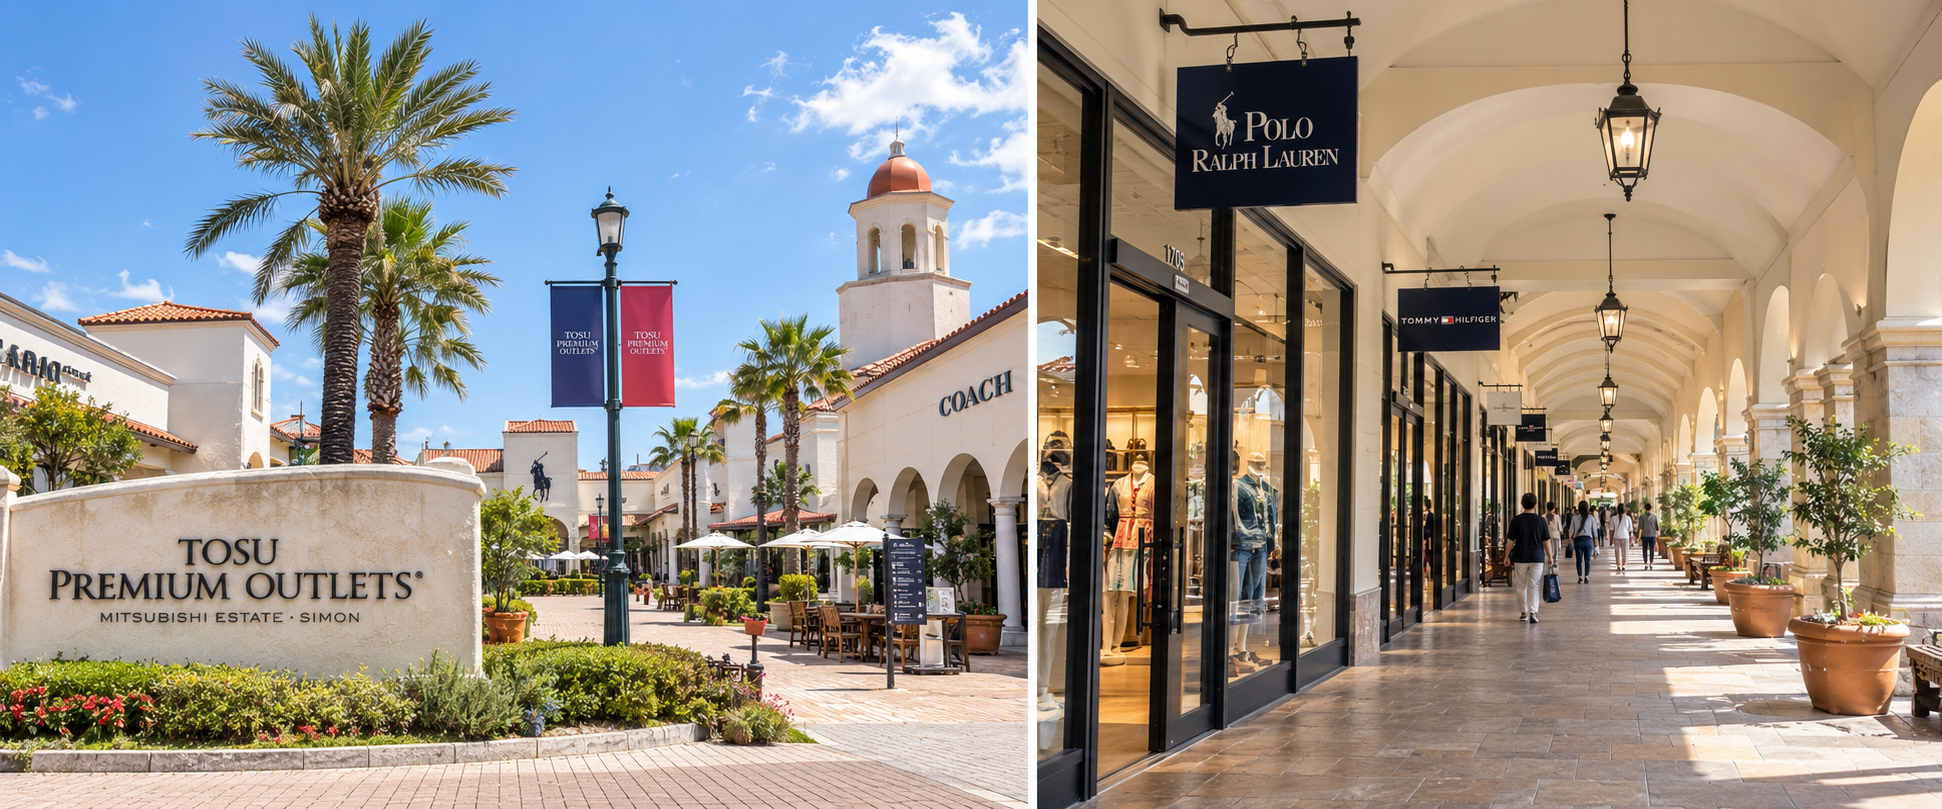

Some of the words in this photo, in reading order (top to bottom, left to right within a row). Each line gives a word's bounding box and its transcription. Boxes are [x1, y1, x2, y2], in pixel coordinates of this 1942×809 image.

[1244, 111, 1314, 142] POLO
[1191, 149, 1257, 173] RALPH
[1262, 145, 1340, 169] LAUREN
[1401, 316, 1439, 325] TOMMY
[1455, 315, 1497, 324] HILFIGER
[564, 331, 591, 339] TOSU
[634, 331, 661, 339] TOSU
[938, 370, 1013, 417] COACH
[178, 538, 279, 566] TOSU
[49, 569, 231, 601] PREMIUM
[100, 612, 207, 623] MITSUBISHI
[215, 612, 283, 623] ESTATE
[299, 612, 361, 623] SIMON
